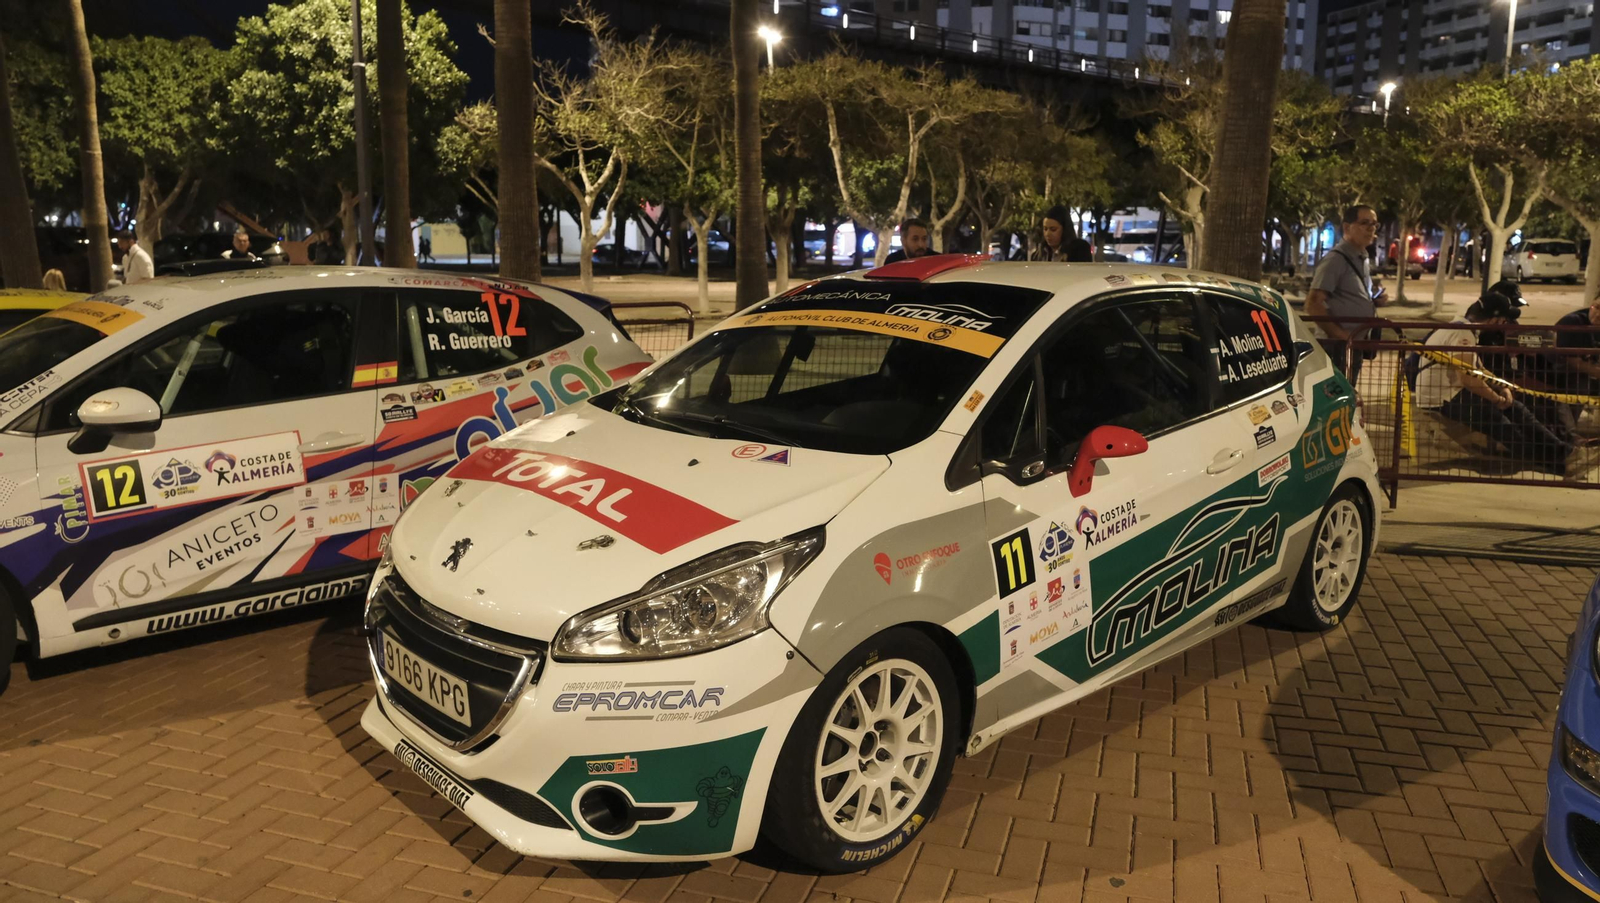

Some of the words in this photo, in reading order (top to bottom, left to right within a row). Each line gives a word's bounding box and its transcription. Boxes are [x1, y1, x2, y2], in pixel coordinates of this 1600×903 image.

[426, 307, 440, 324] J.
[442, 306, 490, 324] García
[481, 292, 527, 336] 12
[766, 314, 822, 323] AUTOMÓVIL
[822, 315, 851, 324] CLUB
[851, 317, 868, 326] DE
[868, 319, 920, 334] ALMERÍA
[890, 306, 993, 331] MOLINA
[427, 333, 446, 351] R.
[448, 333, 512, 350] Guerrero
[1250, 310, 1282, 352] 11
[1219, 339, 1234, 358] A.
[1230, 333, 1265, 355] Molina
[1227, 364, 1241, 383] A.
[1238, 351, 1288, 380] Leseduarte
[9, 385, 49, 410] CEPA
[240, 454, 276, 468] COSTA
[278, 451, 292, 461] DE
[739, 446, 760, 456] E
[95, 464, 140, 509] 12
[232, 462, 296, 485] ALMERÍA
[164, 488, 176, 500] 30
[492, 452, 633, 523] TOTAL
[1100, 505, 1126, 524] COSTA
[1126, 498, 1137, 512] DE
[168, 504, 279, 569] ANICETO
[1094, 512, 1138, 546] ALMERÍA
[196, 533, 262, 571] EVENTOS
[896, 554, 921, 570] OTRO
[1000, 537, 1028, 591] 11
[1048, 559, 1058, 573] 30
[1095, 511, 1280, 660] MOLINA
[386, 640, 424, 693] 9166
[427, 668, 466, 718] KPG
[562, 682, 585, 692] CHAPA
[591, 681, 623, 691] PINTURA
[552, 687, 725, 713] EPROMCAR
[841, 833, 903, 861] MICHELIN
